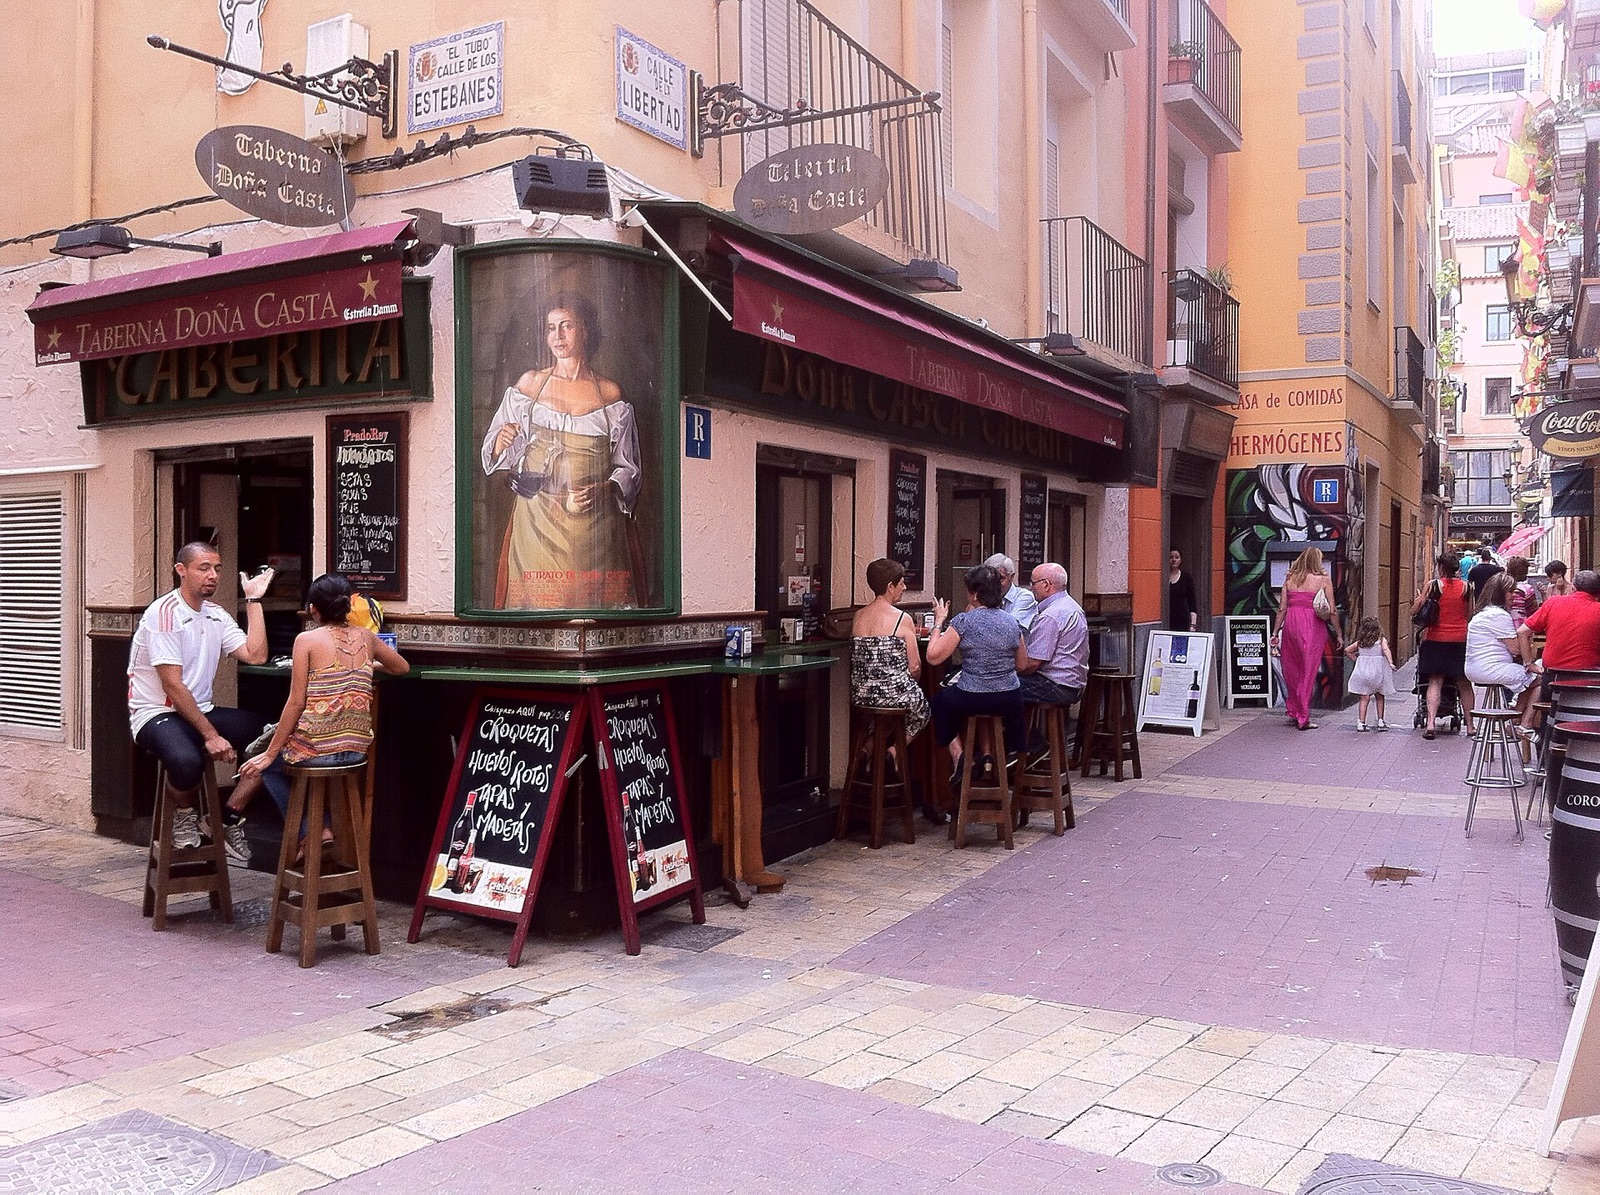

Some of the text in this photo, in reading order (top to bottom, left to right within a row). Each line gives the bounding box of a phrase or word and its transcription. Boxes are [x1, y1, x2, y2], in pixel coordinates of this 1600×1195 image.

[437, 52, 496, 79] CALLE DE LOS
[646, 56, 674, 86] CALLE
[414, 75, 496, 117] ESTEBANES
[622, 80, 681, 132] LIBERTAD
[234, 132, 322, 174] Taberna
[277, 181, 336, 216] Casta
[76, 291, 339, 355] TABERNA DOÑA CASTA
[343, 303, 399, 321] Estrella Damm
[906, 345, 1053, 425] TABERNA DOÑA CASTA
[1266, 392, 1280, 408] de
[1288, 387, 1343, 407] COMIDAS
[693, 413, 705, 442] R
[1229, 428, 1342, 457] HERMÓGENES
[1320, 482, 1332, 496] R
[1465, 514, 1505, 523] CINEGIA
[479, 716, 559, 752] CROQUETAS
[606, 713, 657, 742] CROQUETAS
[468, 749, 553, 793] HUEVOS ROTOS
[613, 739, 670, 779] HUEVOS ROTOS
[475, 782, 516, 812] TAPAS
[625, 775, 656, 800] TAPAS
[1566, 793, 1600, 808] CORO
[634, 796, 675, 835] MADEJAS
[476, 810, 535, 854] MADEJAS
